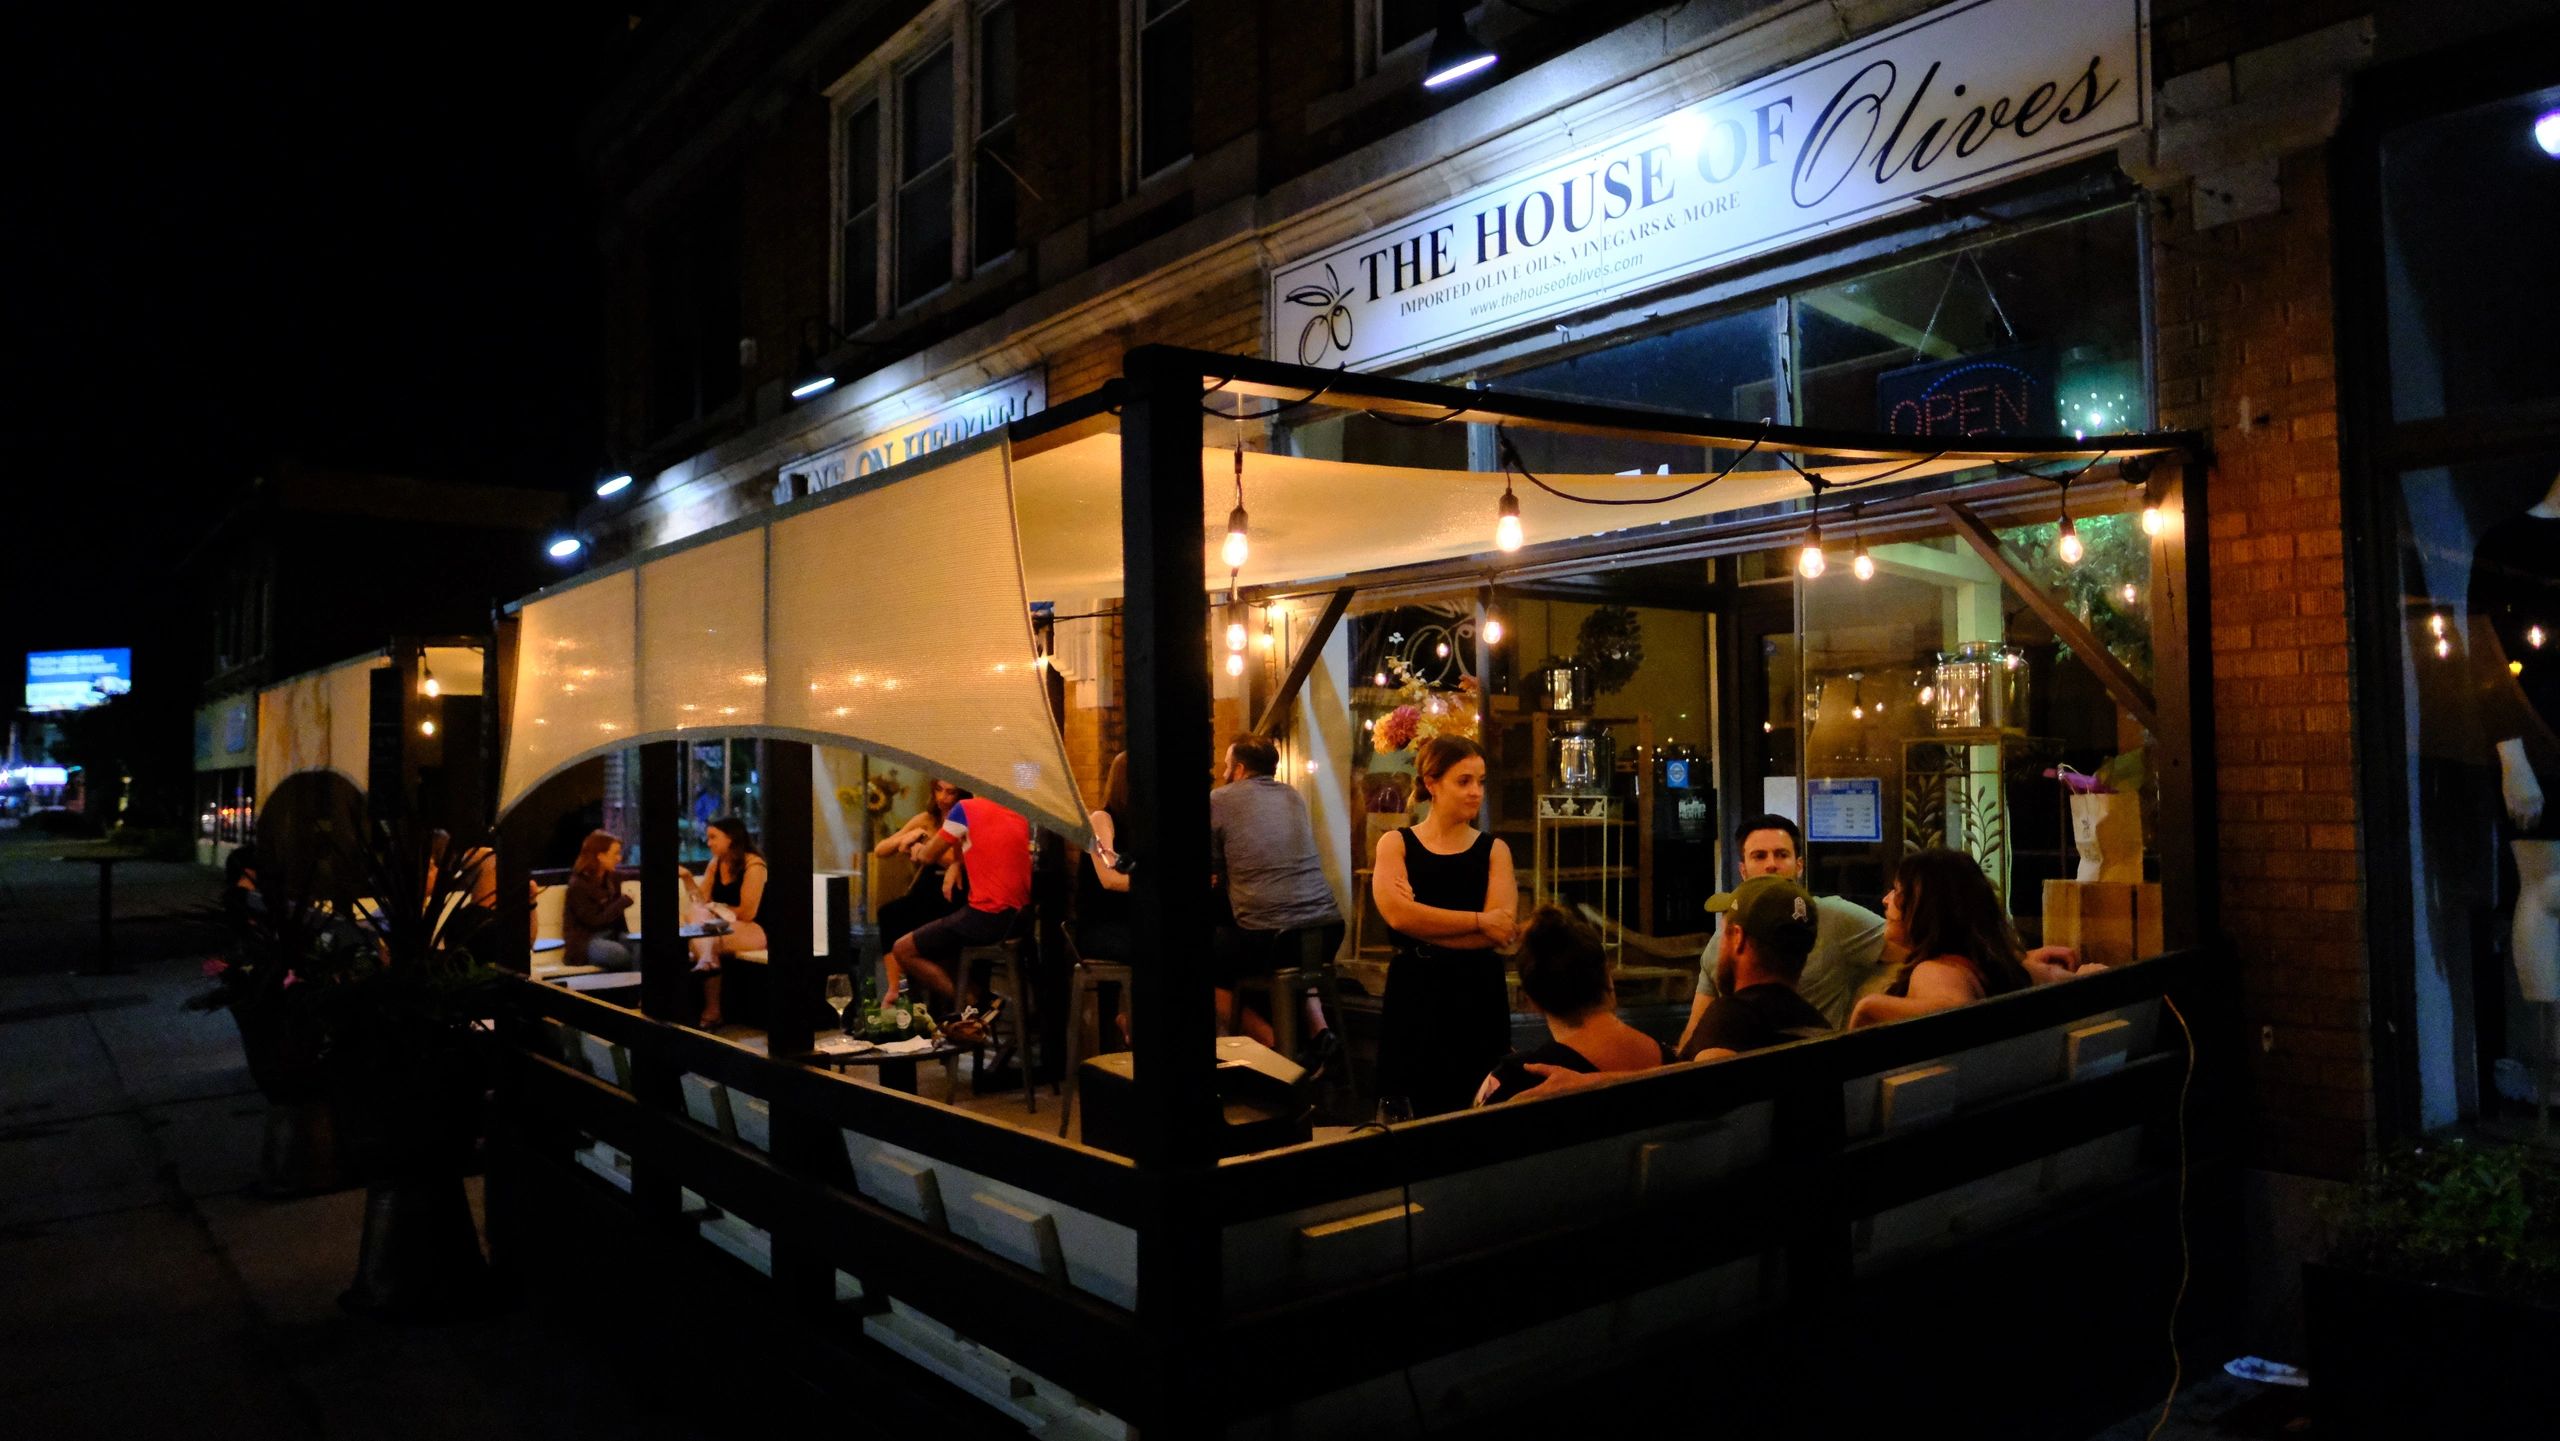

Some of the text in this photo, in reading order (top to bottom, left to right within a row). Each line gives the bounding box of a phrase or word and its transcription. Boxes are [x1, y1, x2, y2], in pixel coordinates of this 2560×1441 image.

[1359, 56, 2120, 303] THE HOUSE OF Olives
[1400, 281, 1471, 317] IMPORTED
[1475, 265, 1522, 292] OLIVE
[1571, 220, 1660, 258] VINEGARS
[1664, 212, 1676, 231] &
[1683, 191, 1741, 225] MORE
[1469, 253, 1643, 316] www.thehouseofolives.com
[1889, 377, 2028, 436] OPEN
